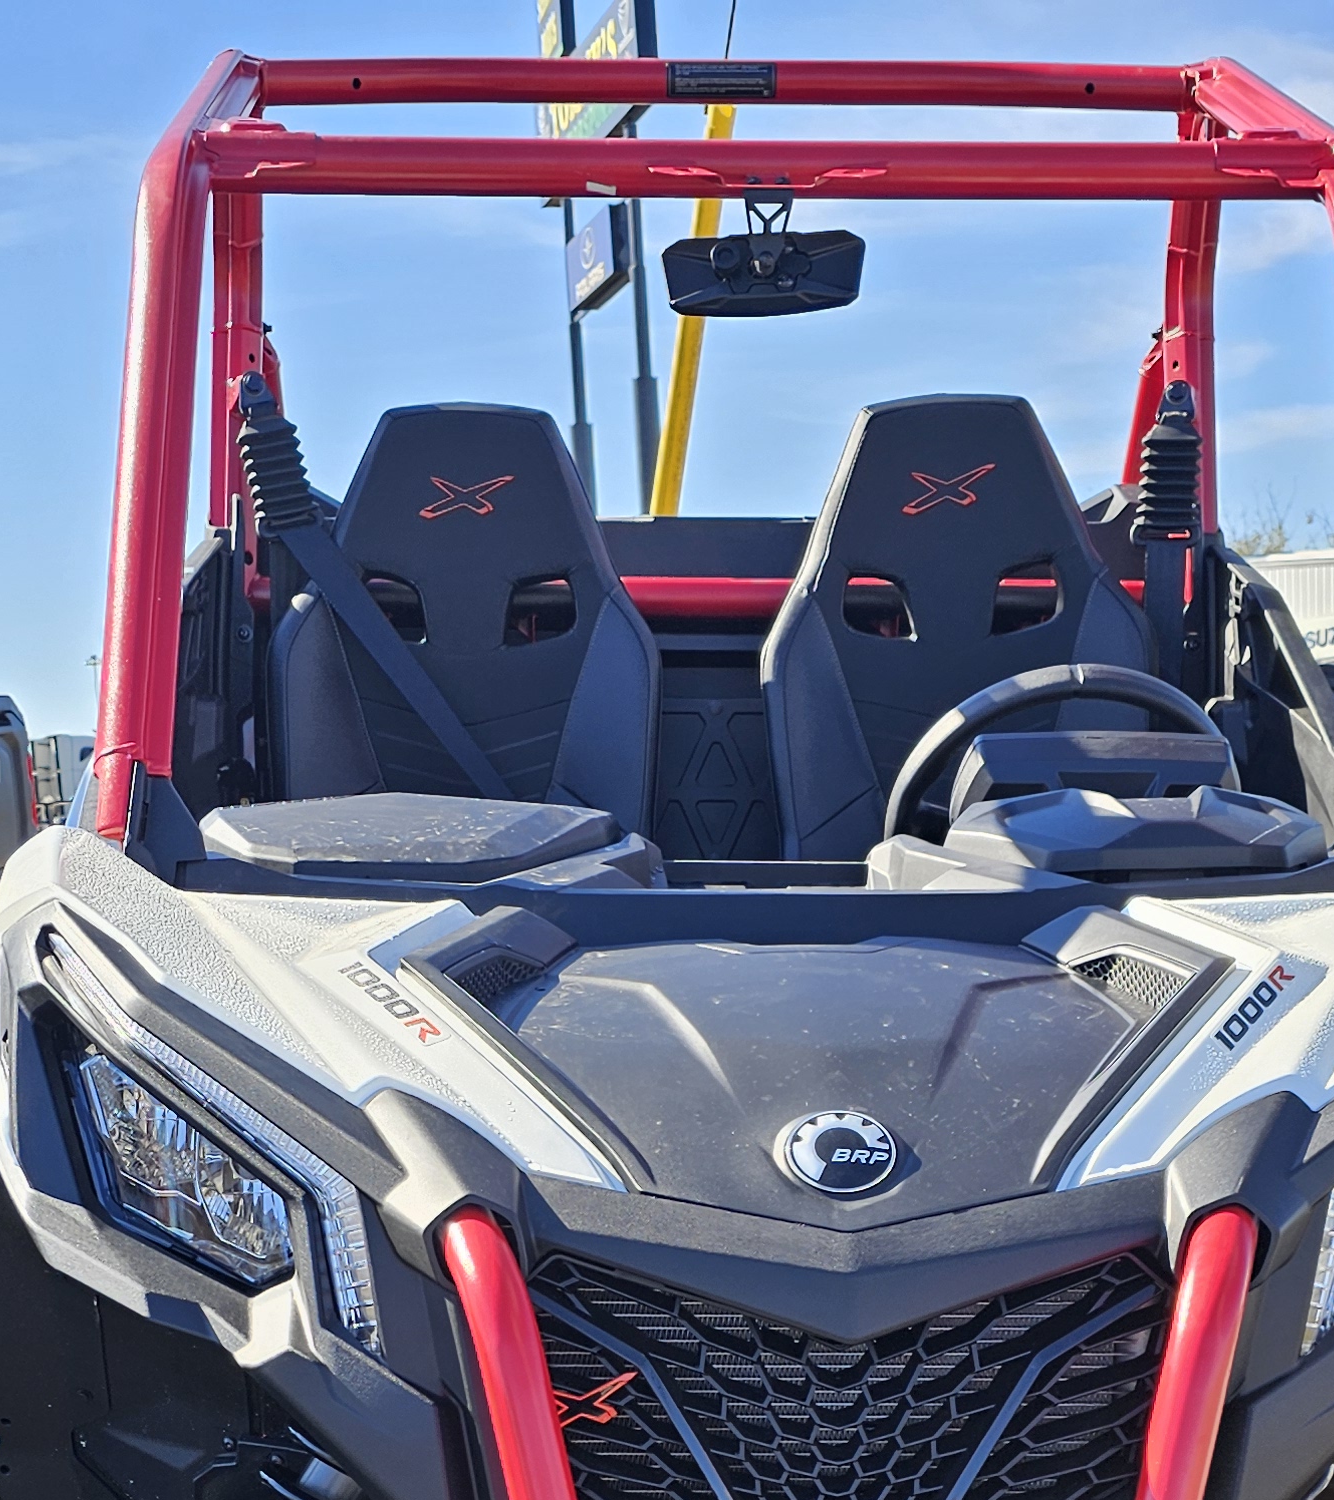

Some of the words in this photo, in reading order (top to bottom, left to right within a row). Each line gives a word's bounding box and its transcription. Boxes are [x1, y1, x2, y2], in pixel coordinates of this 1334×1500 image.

[338, 961, 442, 1044] 1000R
[1214, 965, 1295, 1051] 1000R
[831, 1148, 889, 1165] BRP
